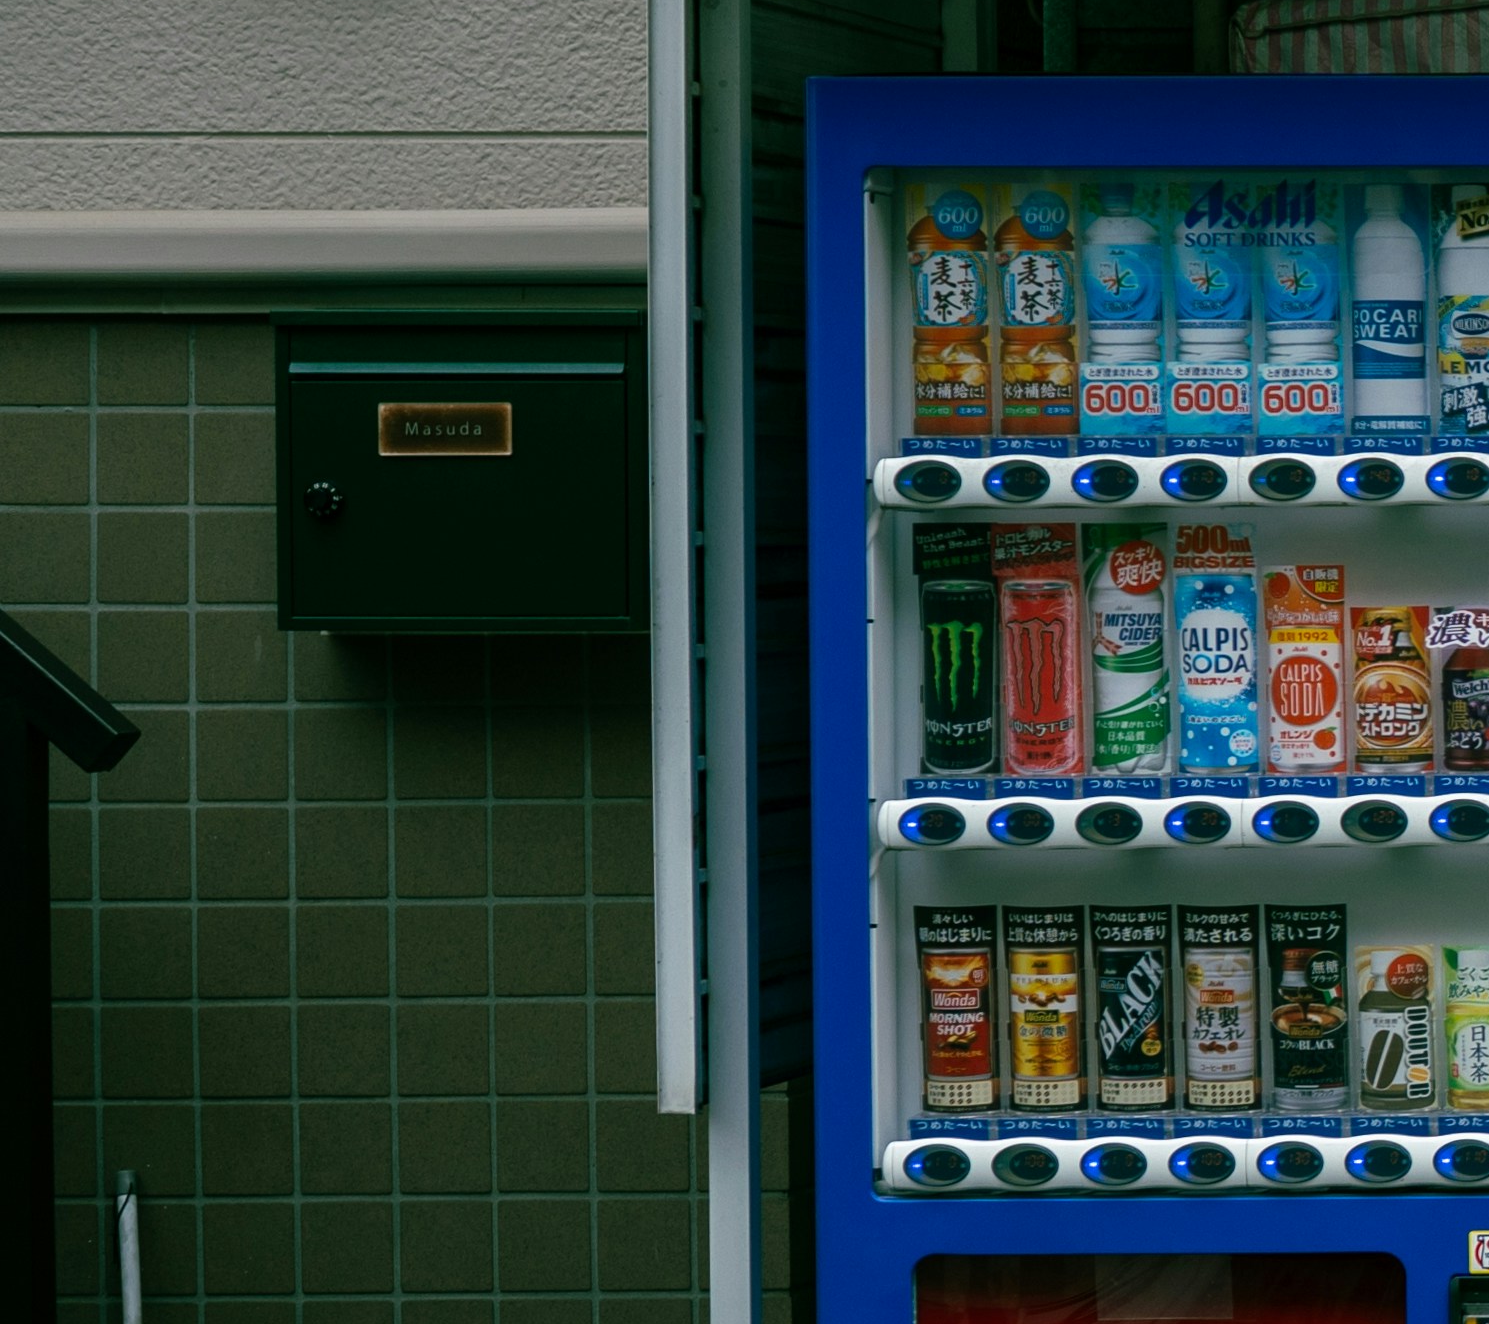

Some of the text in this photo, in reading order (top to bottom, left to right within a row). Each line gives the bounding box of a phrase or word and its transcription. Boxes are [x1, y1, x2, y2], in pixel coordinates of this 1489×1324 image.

[1184, 178, 1316, 229] Asahi
[938, 207, 979, 225] 600
[1025, 207, 1065, 225] 600
[1184, 232, 1316, 248] SOFT DRINKS
[930, 256, 963, 323] 麦茶
[956, 260, 977, 311] 十六茶
[1017, 256, 1050, 323] 麦茶
[1044, 260, 1065, 311] 十六茶
[1354, 325, 1418, 339] SWEAT
[1088, 366, 1155, 377] とぎ澄まされた水
[1177, 366, 1243, 377] とぎ澄まされた水
[1266, 366, 1333, 377] とぎ澄まされた水
[916, 383, 985, 399] 水分補給に!
[1003, 383, 1073, 399] 水分補給に!
[405, 421, 483, 437] Masuda
[1176, 525, 1252, 555] 500ml
[1115, 545, 1157, 566] スッキリ
[1116, 559, 1162, 588] 爽快
[1303, 569, 1339, 581] 自販機
[1314, 581, 1339, 594] 限定
[1103, 613, 1162, 628] MITSUYA
[1118, 627, 1162, 642] CIDER
[1182, 627, 1250, 652] CALPIS
[1356, 624, 1393, 648] No.1
[1182, 653, 1251, 674] SODA
[1187, 676, 1244, 686] カルピスソーダ
[1280, 664, 1323, 683] CALPIS
[1281, 682, 1326, 717] SODA
[1356, 702, 1430, 722] ドデカミン
[1107, 731, 1145, 742] 日本品質
[1280, 730, 1314, 741] オレンジ
[1361, 721, 1420, 737] ストロング
[1008, 914, 1074, 924] いいはじまりは
[1186, 913, 1249, 924] ミルクの甘みで
[1007, 927, 1079, 943] 上質な休憩から
[1095, 925, 1167, 941] くつろぎの香り
[1184, 927, 1253, 943] 満たされる
[1271, 923, 1341, 941] 深いコク
[1311, 959, 1340, 976] 無糖
[1395, 963, 1425, 975] 上質な
[934, 991, 977, 1008] Wonda
[1099, 951, 1165, 1061] BLACK
[929, 1012, 985, 1023] MORNING
[1196, 1006, 1240, 1028] 特製
[936, 1024, 976, 1036] SHOT
[1191, 1028, 1246, 1041] カフェオレ
[1405, 1005, 1430, 1099] DOUTOR
